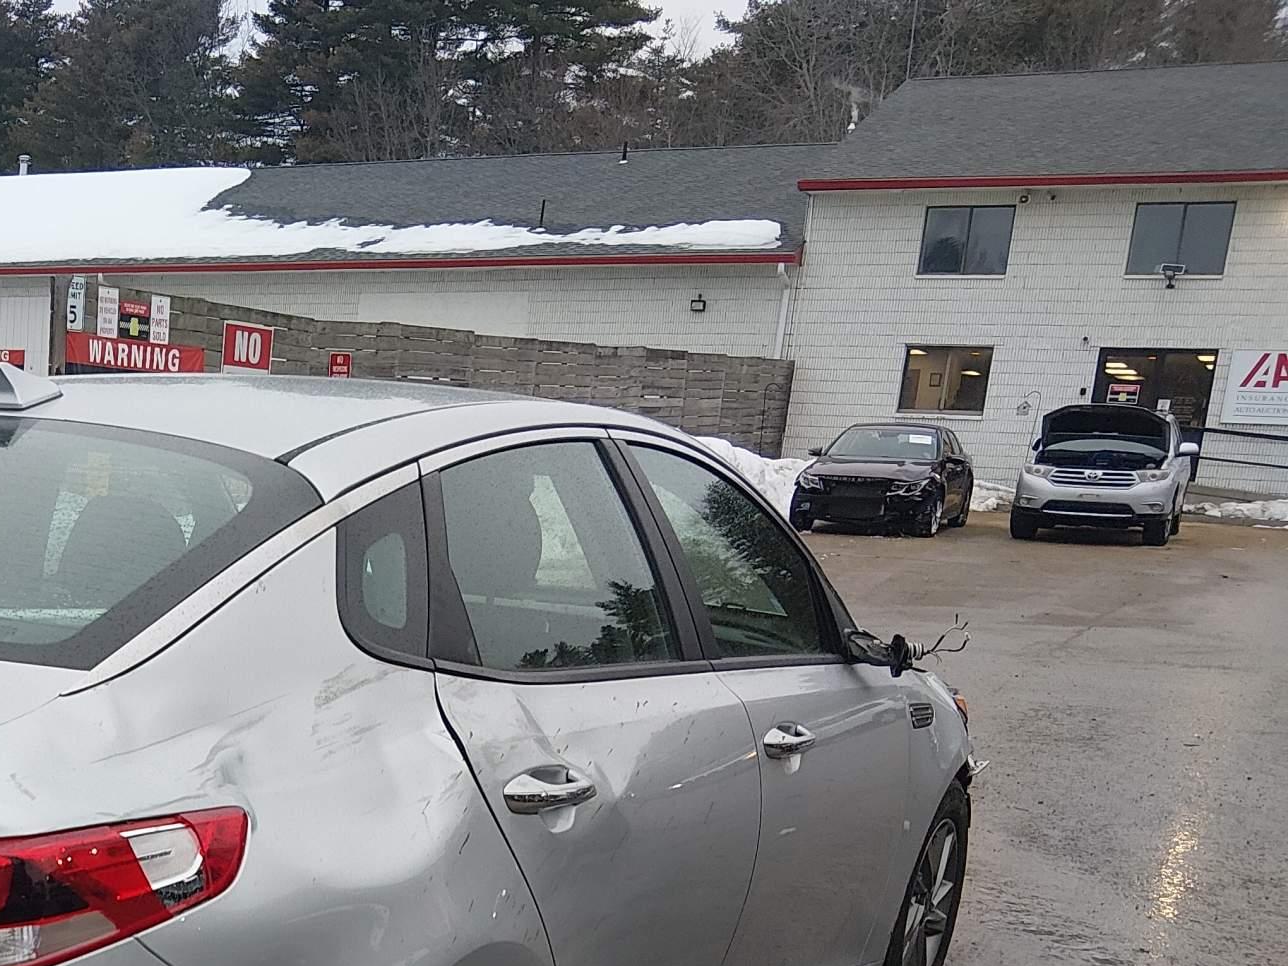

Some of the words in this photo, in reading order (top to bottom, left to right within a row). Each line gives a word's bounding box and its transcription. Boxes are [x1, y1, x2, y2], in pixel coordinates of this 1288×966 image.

[69, 305, 77, 324] 5
[156, 305, 165, 315] NO
[152, 318, 168, 329] PARTS
[152, 331, 166, 341] SOLD
[88, 338, 180, 372] WARNING
[234, 330, 262, 365] NO
